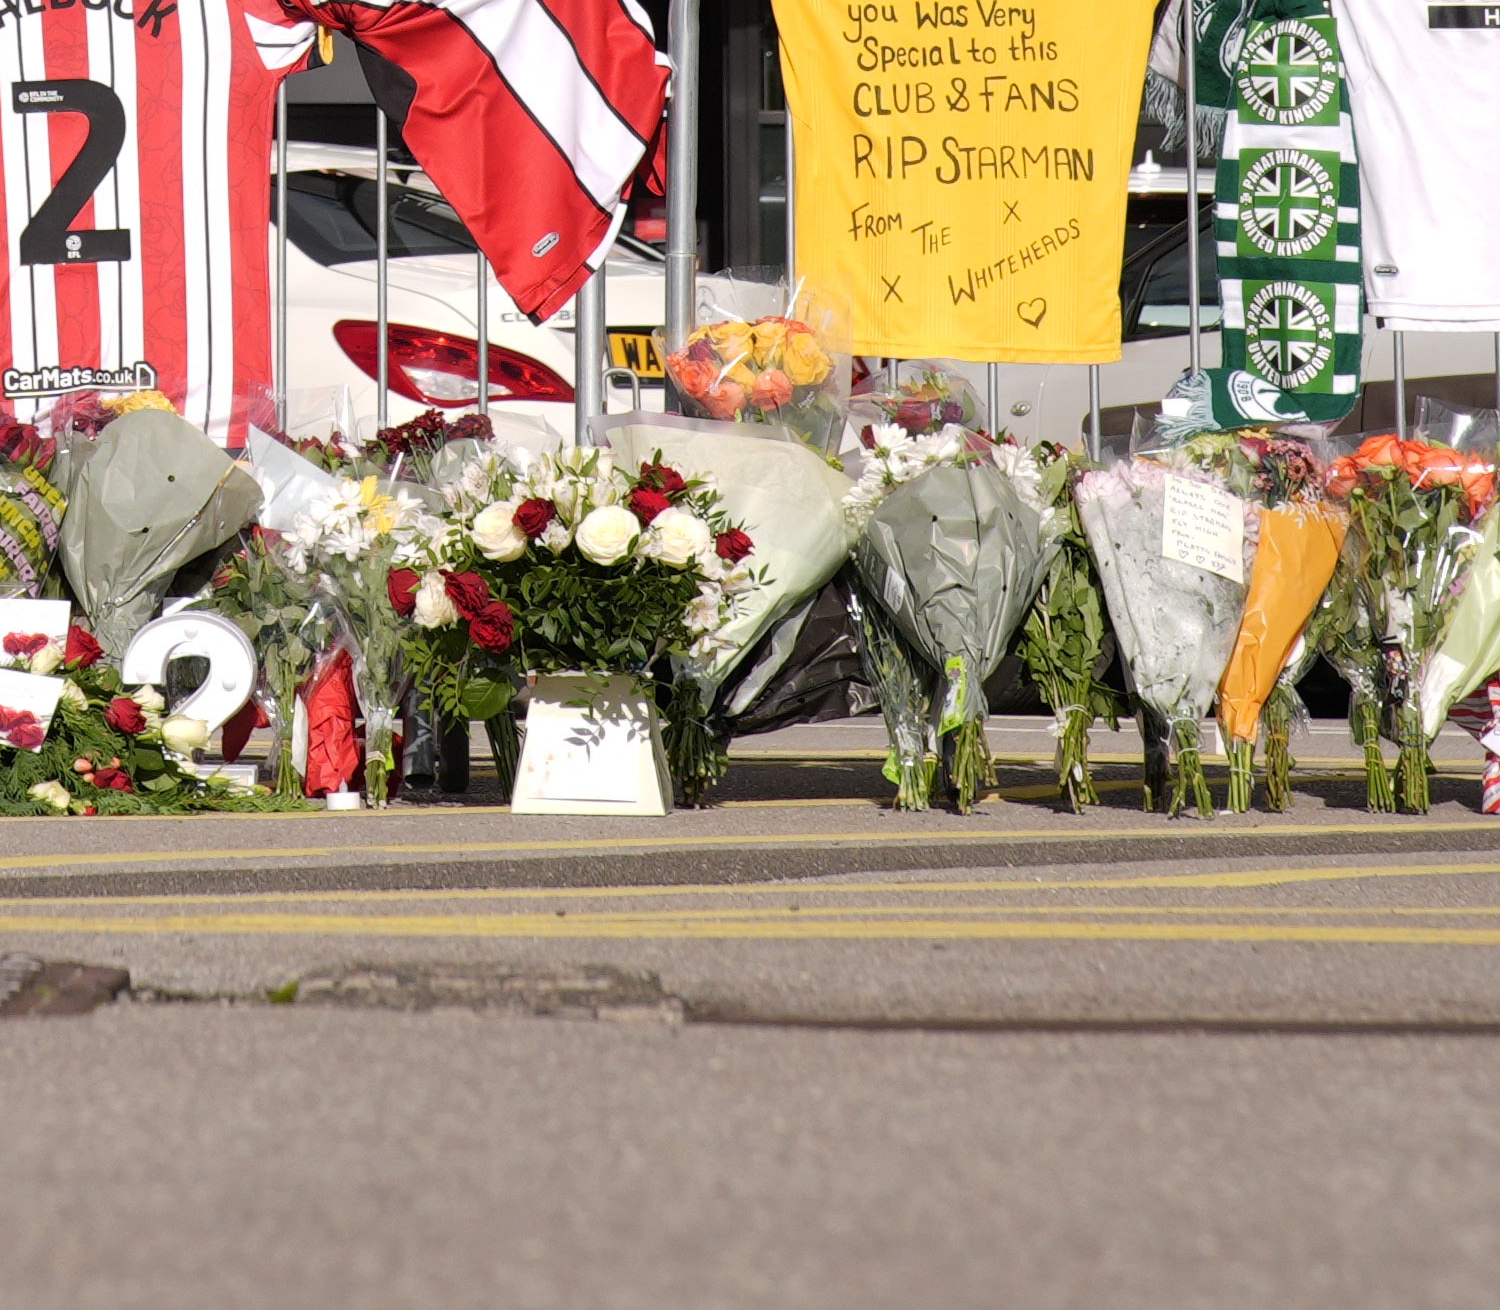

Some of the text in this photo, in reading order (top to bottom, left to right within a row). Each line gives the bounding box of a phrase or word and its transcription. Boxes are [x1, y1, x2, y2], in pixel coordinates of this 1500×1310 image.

[968, 39, 998, 66] to
[1008, 32, 1059, 63] this
[1241, 19, 1333, 60] PANATHINAIKOS
[852, 75, 1080, 119] CLUB & FANS
[10, 78, 132, 267] 2
[853, 133, 1095, 186] RIP STARMAN
[1242, 149, 1334, 193] PANATHINAIKOS
[1246, 281, 1331, 325] PANATHINAIKOS
[3, 366, 134, 393] CarMats.co.uk
